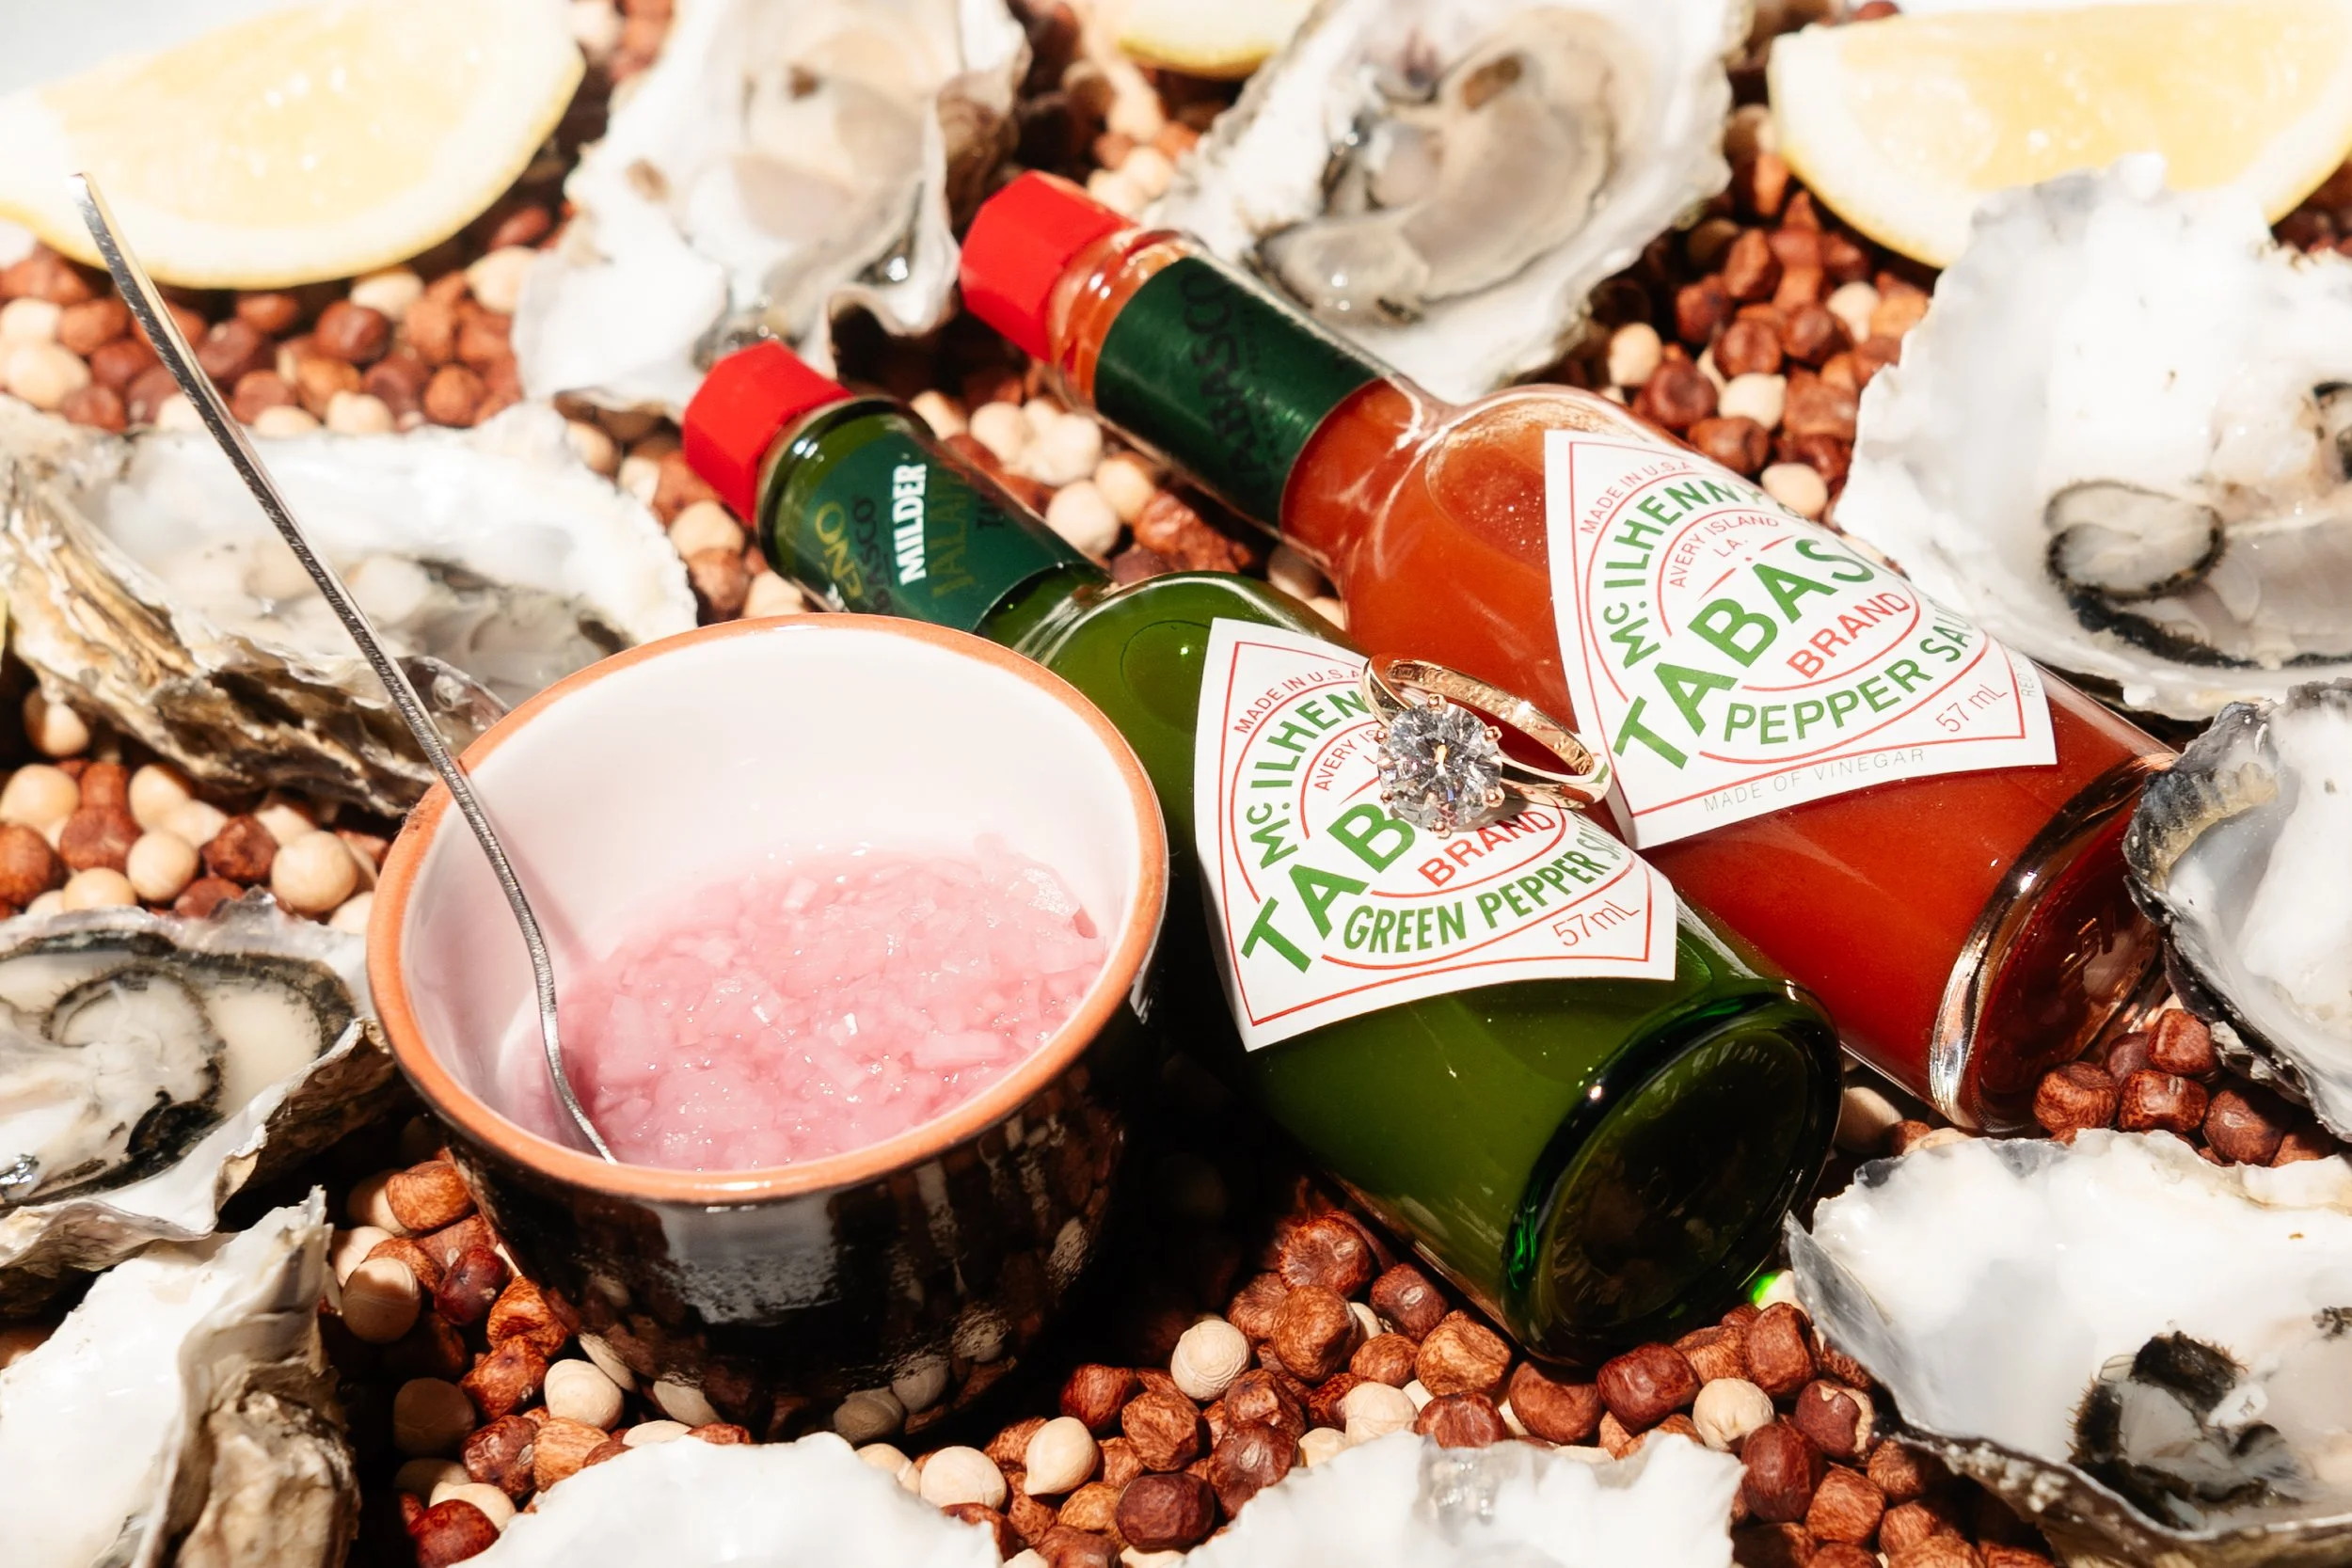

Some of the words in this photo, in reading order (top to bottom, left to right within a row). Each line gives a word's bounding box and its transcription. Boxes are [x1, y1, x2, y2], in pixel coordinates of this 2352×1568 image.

[893, 463, 928, 586] MILDER
[1579, 484, 1623, 535] MADE
[1619, 471, 1643, 488] IN
[1668, 532, 1707, 589] AVERY
[1706, 515, 1780, 536] ISLAND
[1712, 537, 1749, 559] LA.
[1613, 538, 1889, 769] TABAS
[1724, 658, 1934, 746] PEPPER
[1919, 598, 1975, 663] SAU
[1787, 592, 1912, 679] BRAND
[1232, 688, 1286, 735] MADE
[1281, 676, 1307, 692] IN
[1935, 702, 1970, 733] 57
[1967, 683, 2009, 710] mL
[1313, 738, 1358, 792] AVERY
[1704, 780, 1763, 813] MADE
[1774, 770, 1803, 793] OF
[1812, 748, 1925, 782] VINEGAR
[1418, 810, 1556, 888] BRAND
[1343, 901, 1467, 954] GREEN
[1475, 850, 1612, 930] PEPPER
